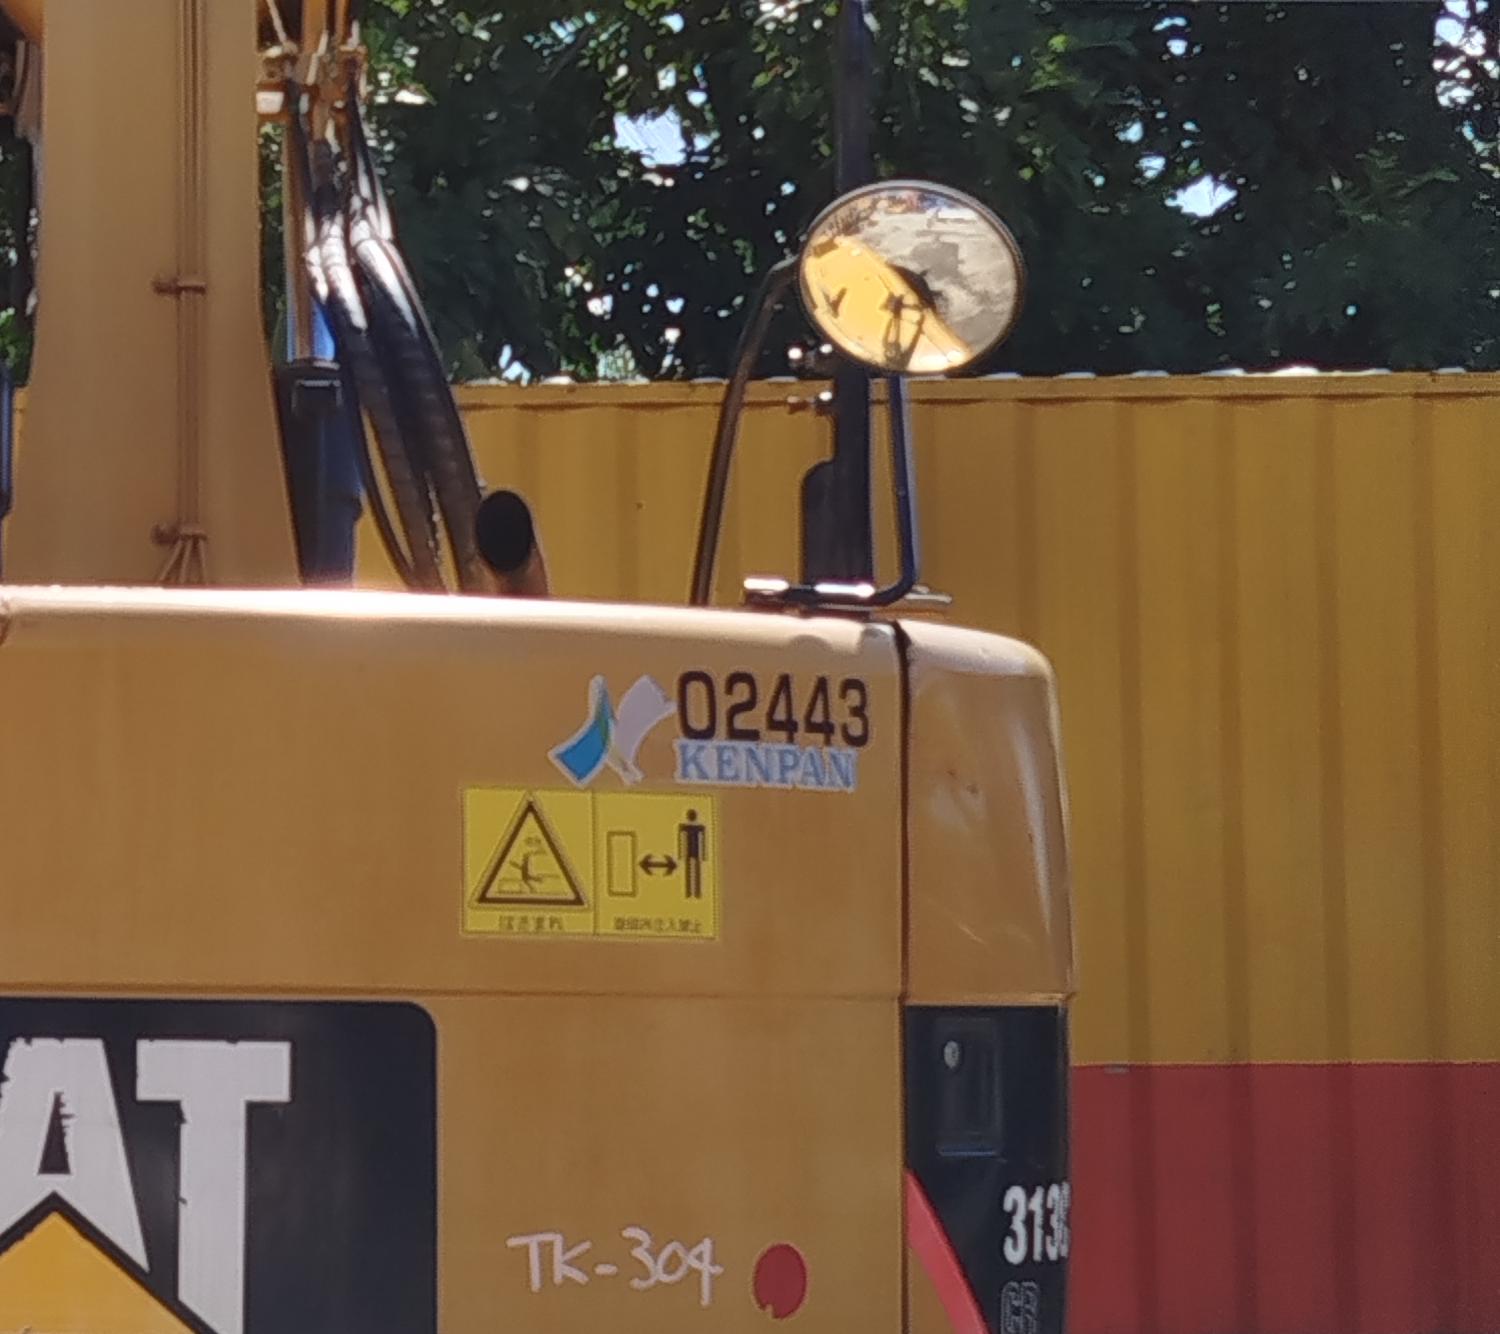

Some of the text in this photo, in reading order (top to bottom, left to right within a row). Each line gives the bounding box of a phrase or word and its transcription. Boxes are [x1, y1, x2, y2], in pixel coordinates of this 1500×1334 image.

[678, 670, 870, 747] 02443
[677, 741, 855, 789] KENPAN
[506, 1226, 724, 1306] TK-304
